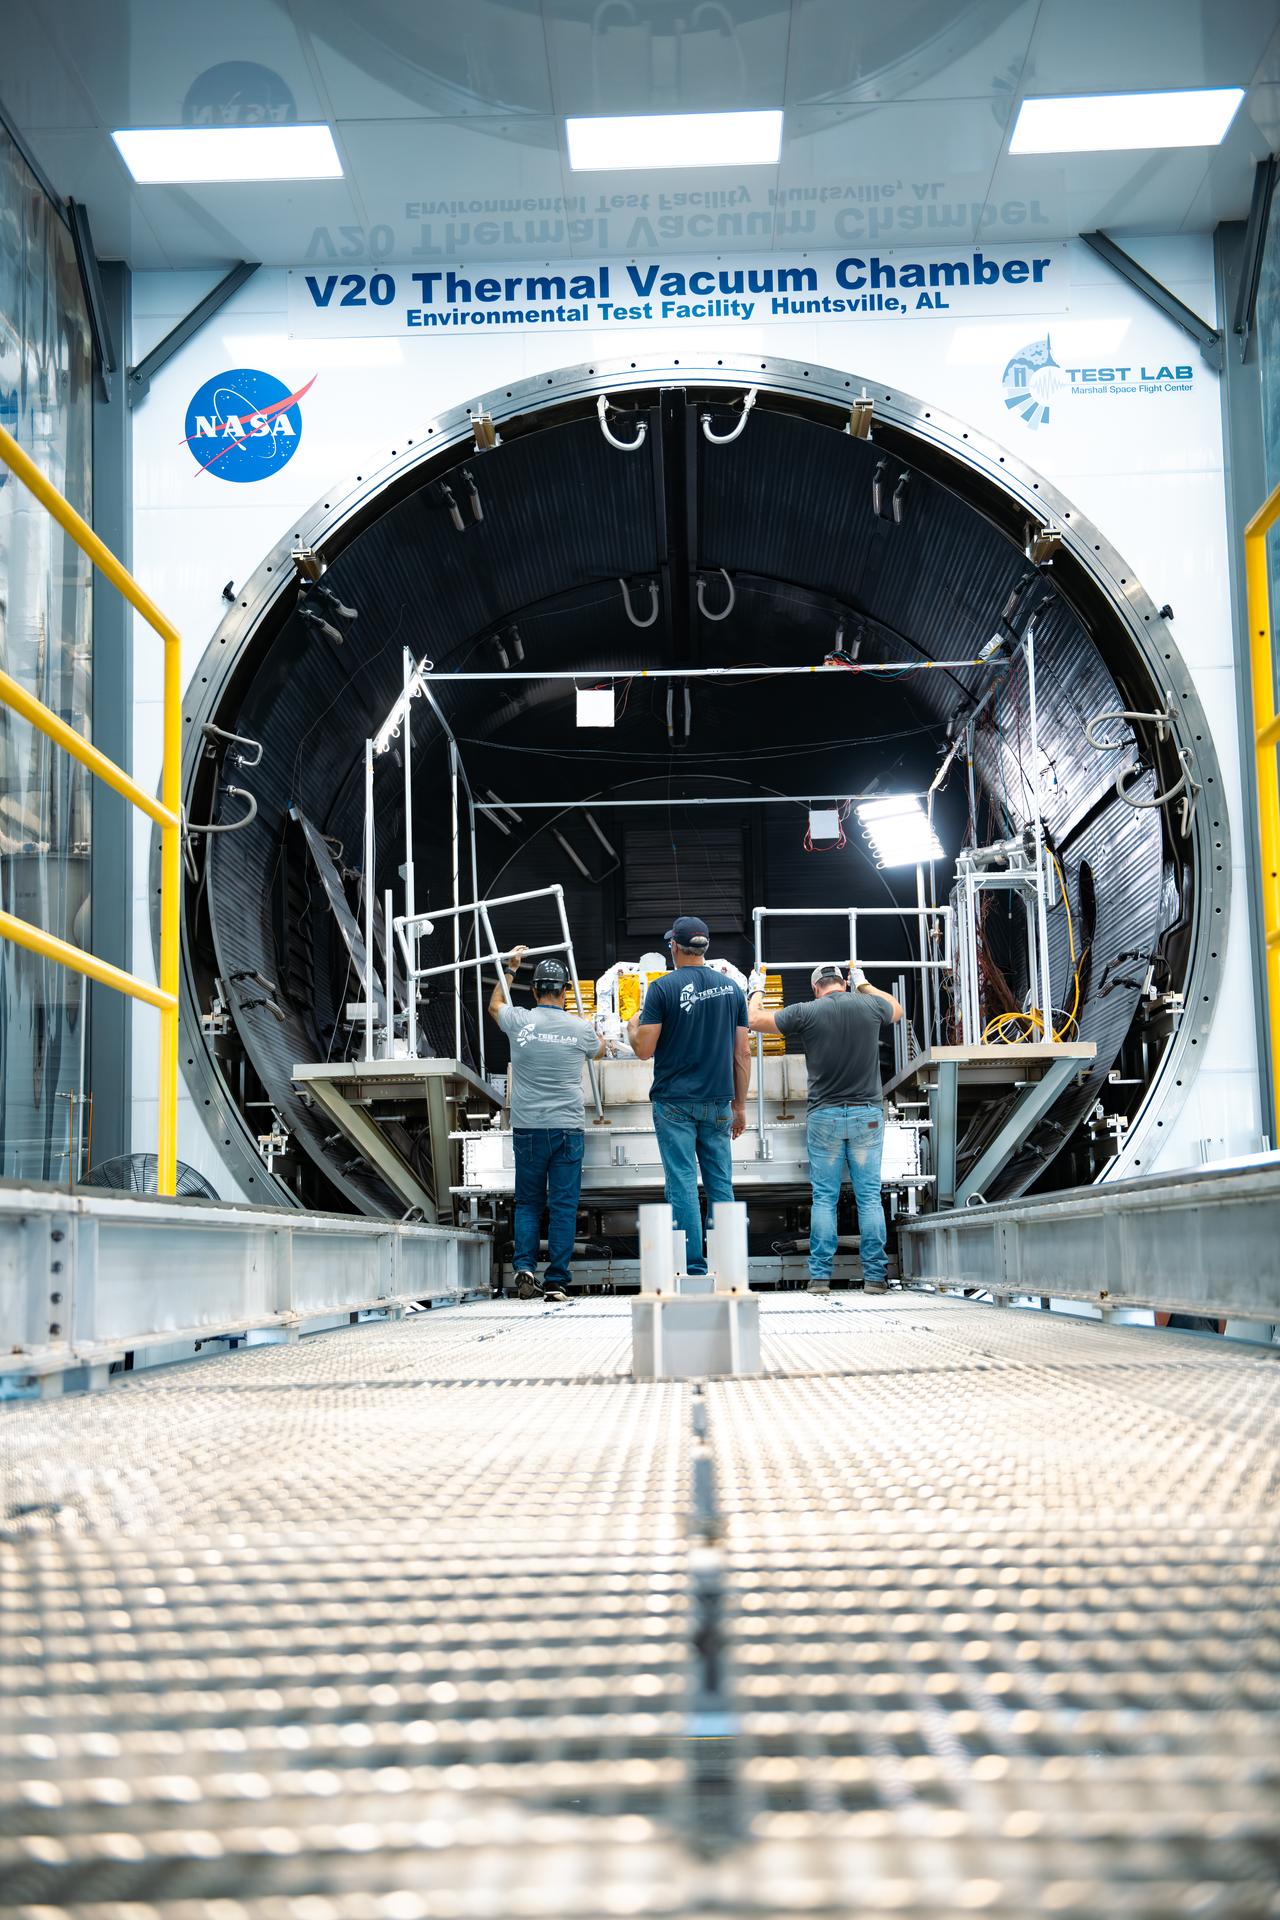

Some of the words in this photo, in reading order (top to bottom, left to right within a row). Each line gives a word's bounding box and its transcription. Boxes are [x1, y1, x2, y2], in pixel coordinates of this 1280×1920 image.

[304, 273, 396, 307] V20
[411, 266, 610, 304] Thermal
[626, 265, 818, 297] Vacuum
[835, 253, 1052, 290] Chamber
[406, 304, 589, 327] Environmental
[597, 302, 653, 321] Test
[661, 299, 755, 321] Facility
[771, 293, 908, 315] Huntsville,
[915, 291, 950, 310] AL
[1065, 367, 1132, 382] TEST
[1140, 365, 1194, 381] LAB
[1071, 386, 1108, 395] Marshall
[1109, 386, 1137, 395] Space
[1138, 384, 1163, 394] Flight
[1164, 383, 1194, 392] Center
[194, 413, 297, 438] NASA
[698, 987, 719, 998] TEST
[719, 985, 734, 993] LAB
[537, 1033, 560, 1041] TEST
[560, 1034, 578, 1043] LAB
